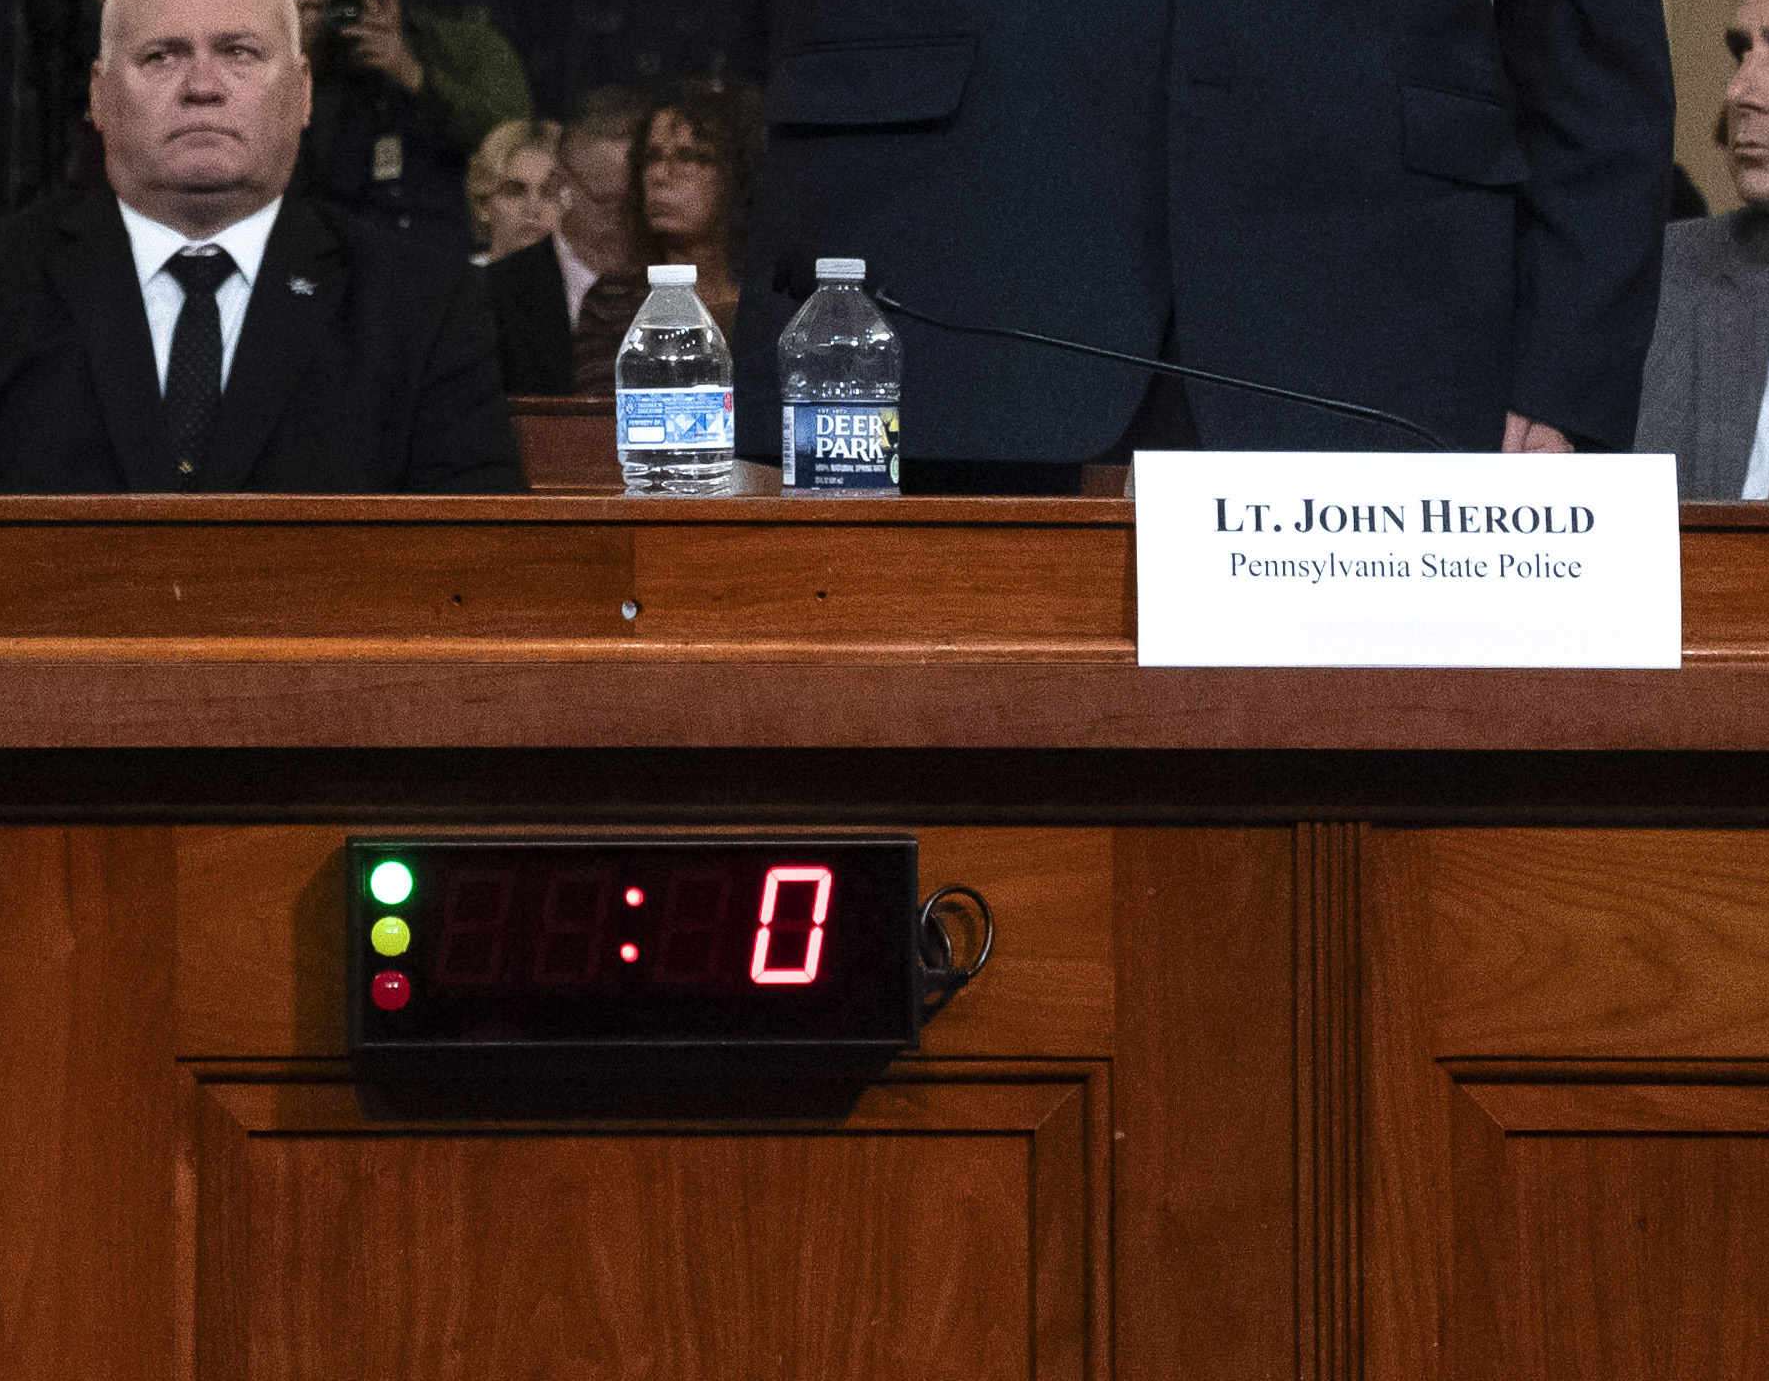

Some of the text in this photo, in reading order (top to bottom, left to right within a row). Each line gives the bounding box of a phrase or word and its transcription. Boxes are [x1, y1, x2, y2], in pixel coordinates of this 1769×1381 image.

[816, 414, 883, 436] DEER
[815, 437, 884, 462] PARK
[1213, 497, 1596, 535] LT. JOHN HEROLD
[1229, 551, 1583, 585] Pennsylvania State Police
[750, 865, 833, 985] 0
